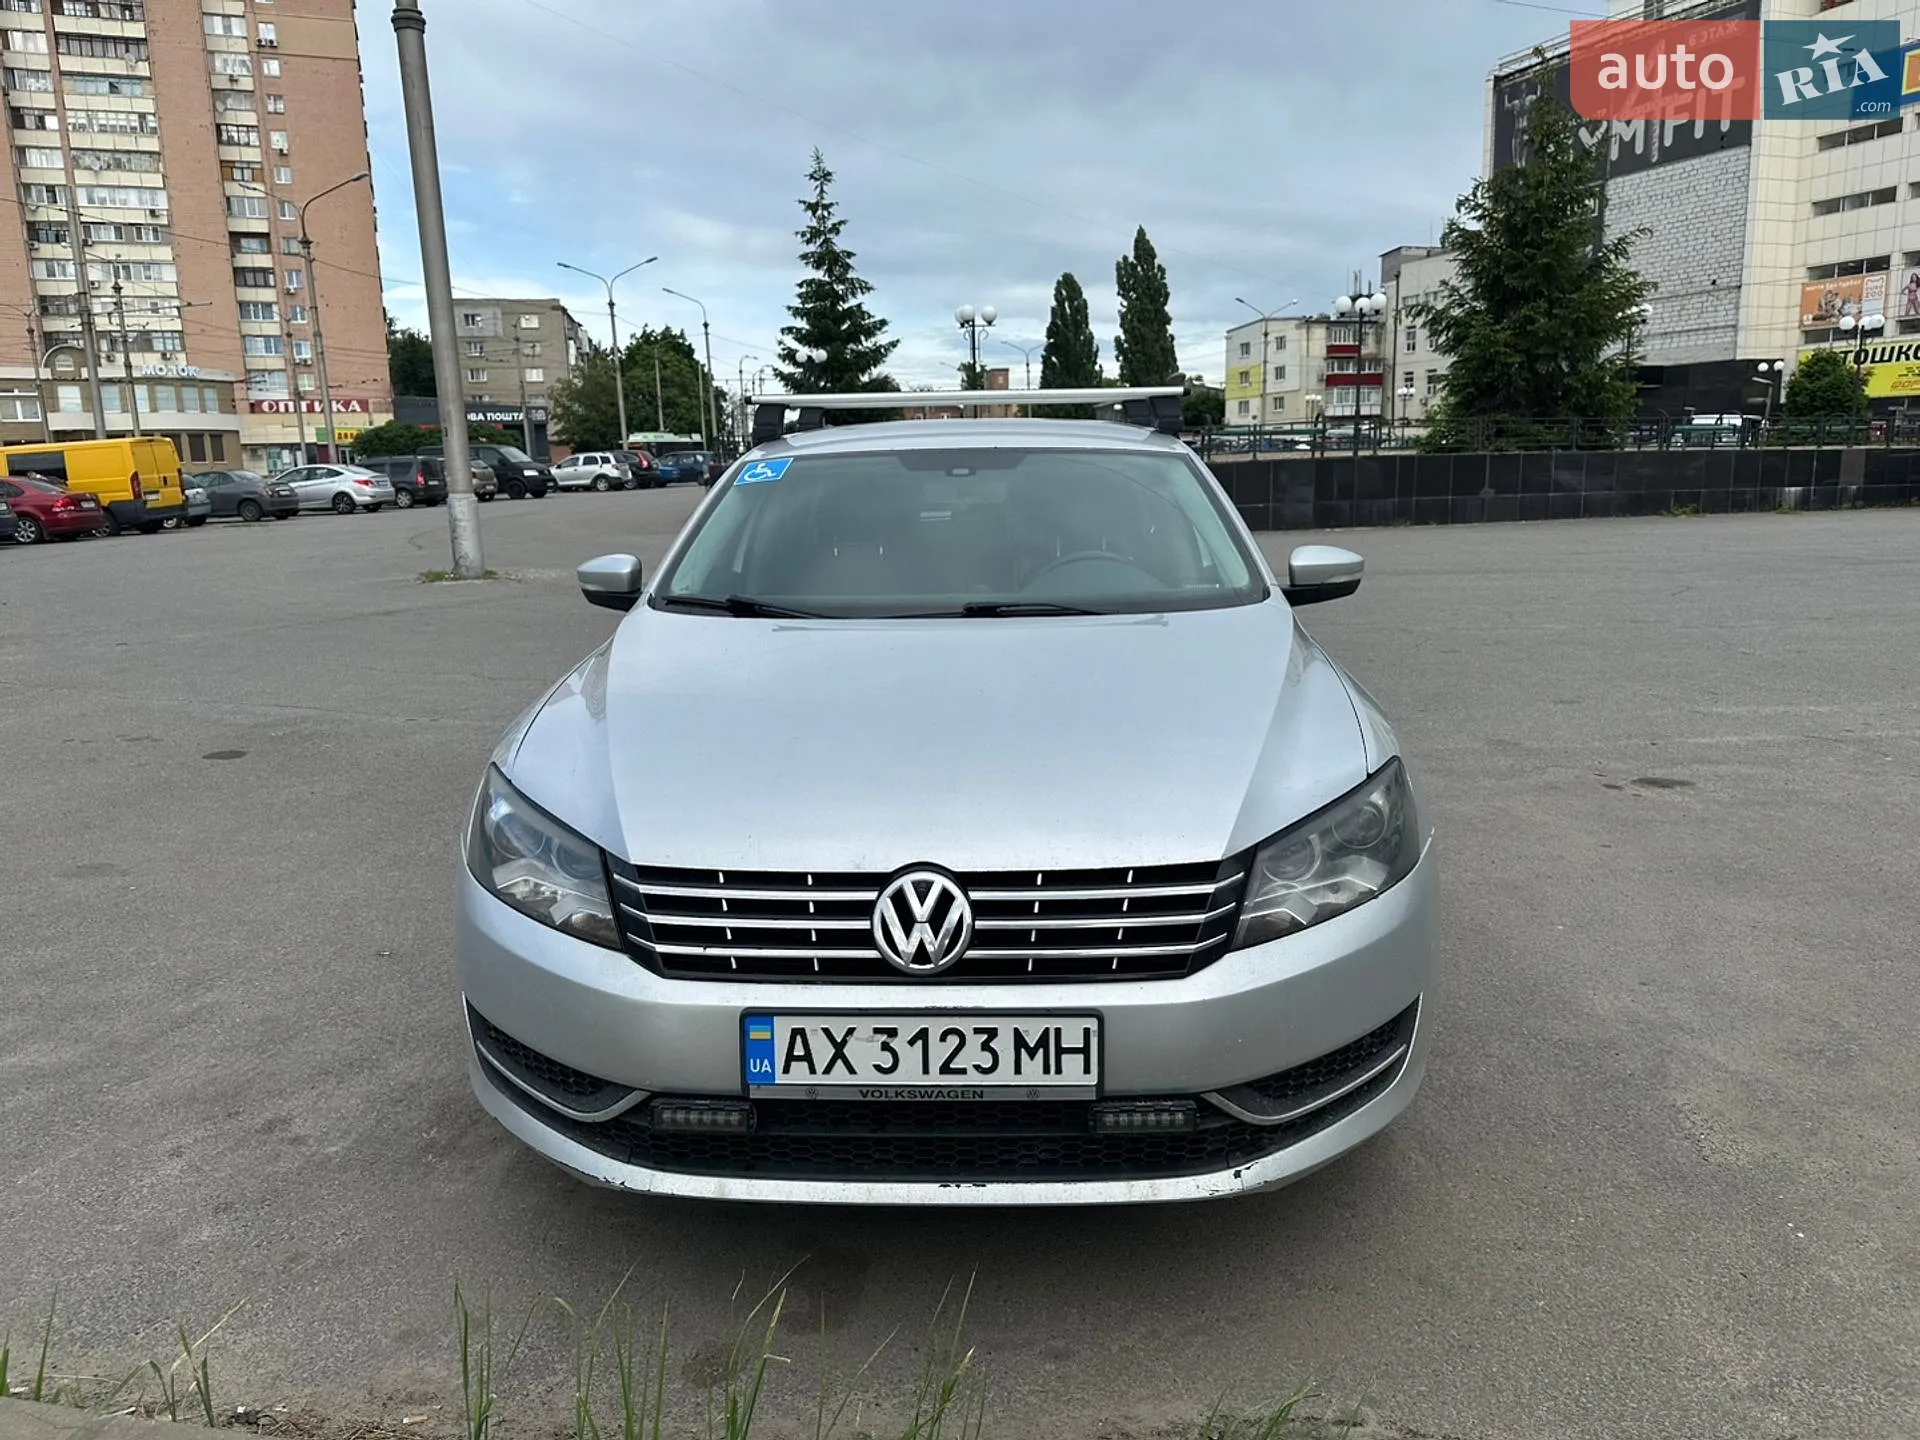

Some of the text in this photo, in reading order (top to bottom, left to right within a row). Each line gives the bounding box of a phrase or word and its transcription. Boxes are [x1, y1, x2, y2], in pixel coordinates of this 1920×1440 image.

[261, 399, 362, 413] ОПТИКА
[782, 1026, 1092, 1075] AX 3123 MH
[750, 1060, 771, 1073] UA
[858, 1088, 985, 1100] VOLKSWAGEN
